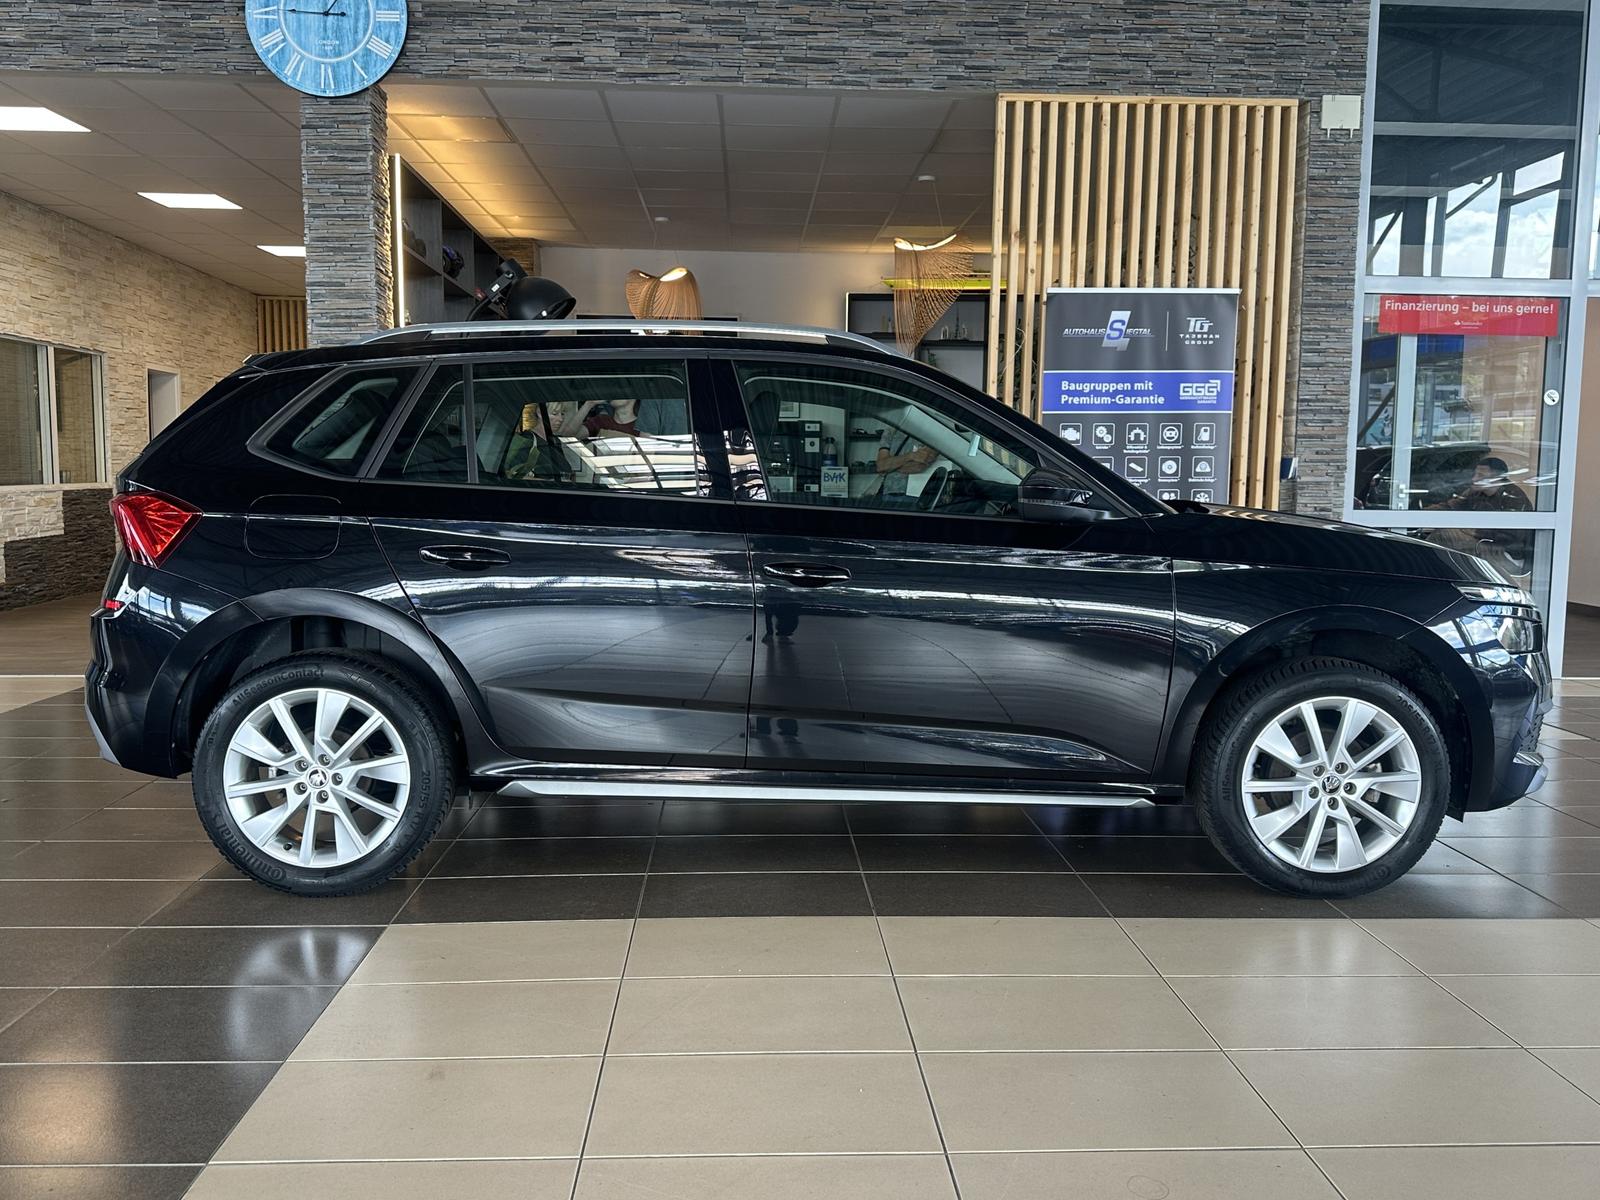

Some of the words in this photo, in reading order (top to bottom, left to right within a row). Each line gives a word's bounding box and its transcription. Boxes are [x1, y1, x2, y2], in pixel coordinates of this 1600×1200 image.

[1385, 300, 1459, 314] Finanzierung
[1471, 301, 1490, 313] bei
[1493, 304, 1513, 313] uns
[1515, 303, 1554, 315] gerne!
[1062, 328, 1106, 336] AUTOHAUS
[1061, 380, 1132, 392] Baugruppen
[1134, 380, 1153, 391] mit
[1180, 381, 1218, 396] GGG
[1061, 394, 1165, 405] Premium-Garantie
